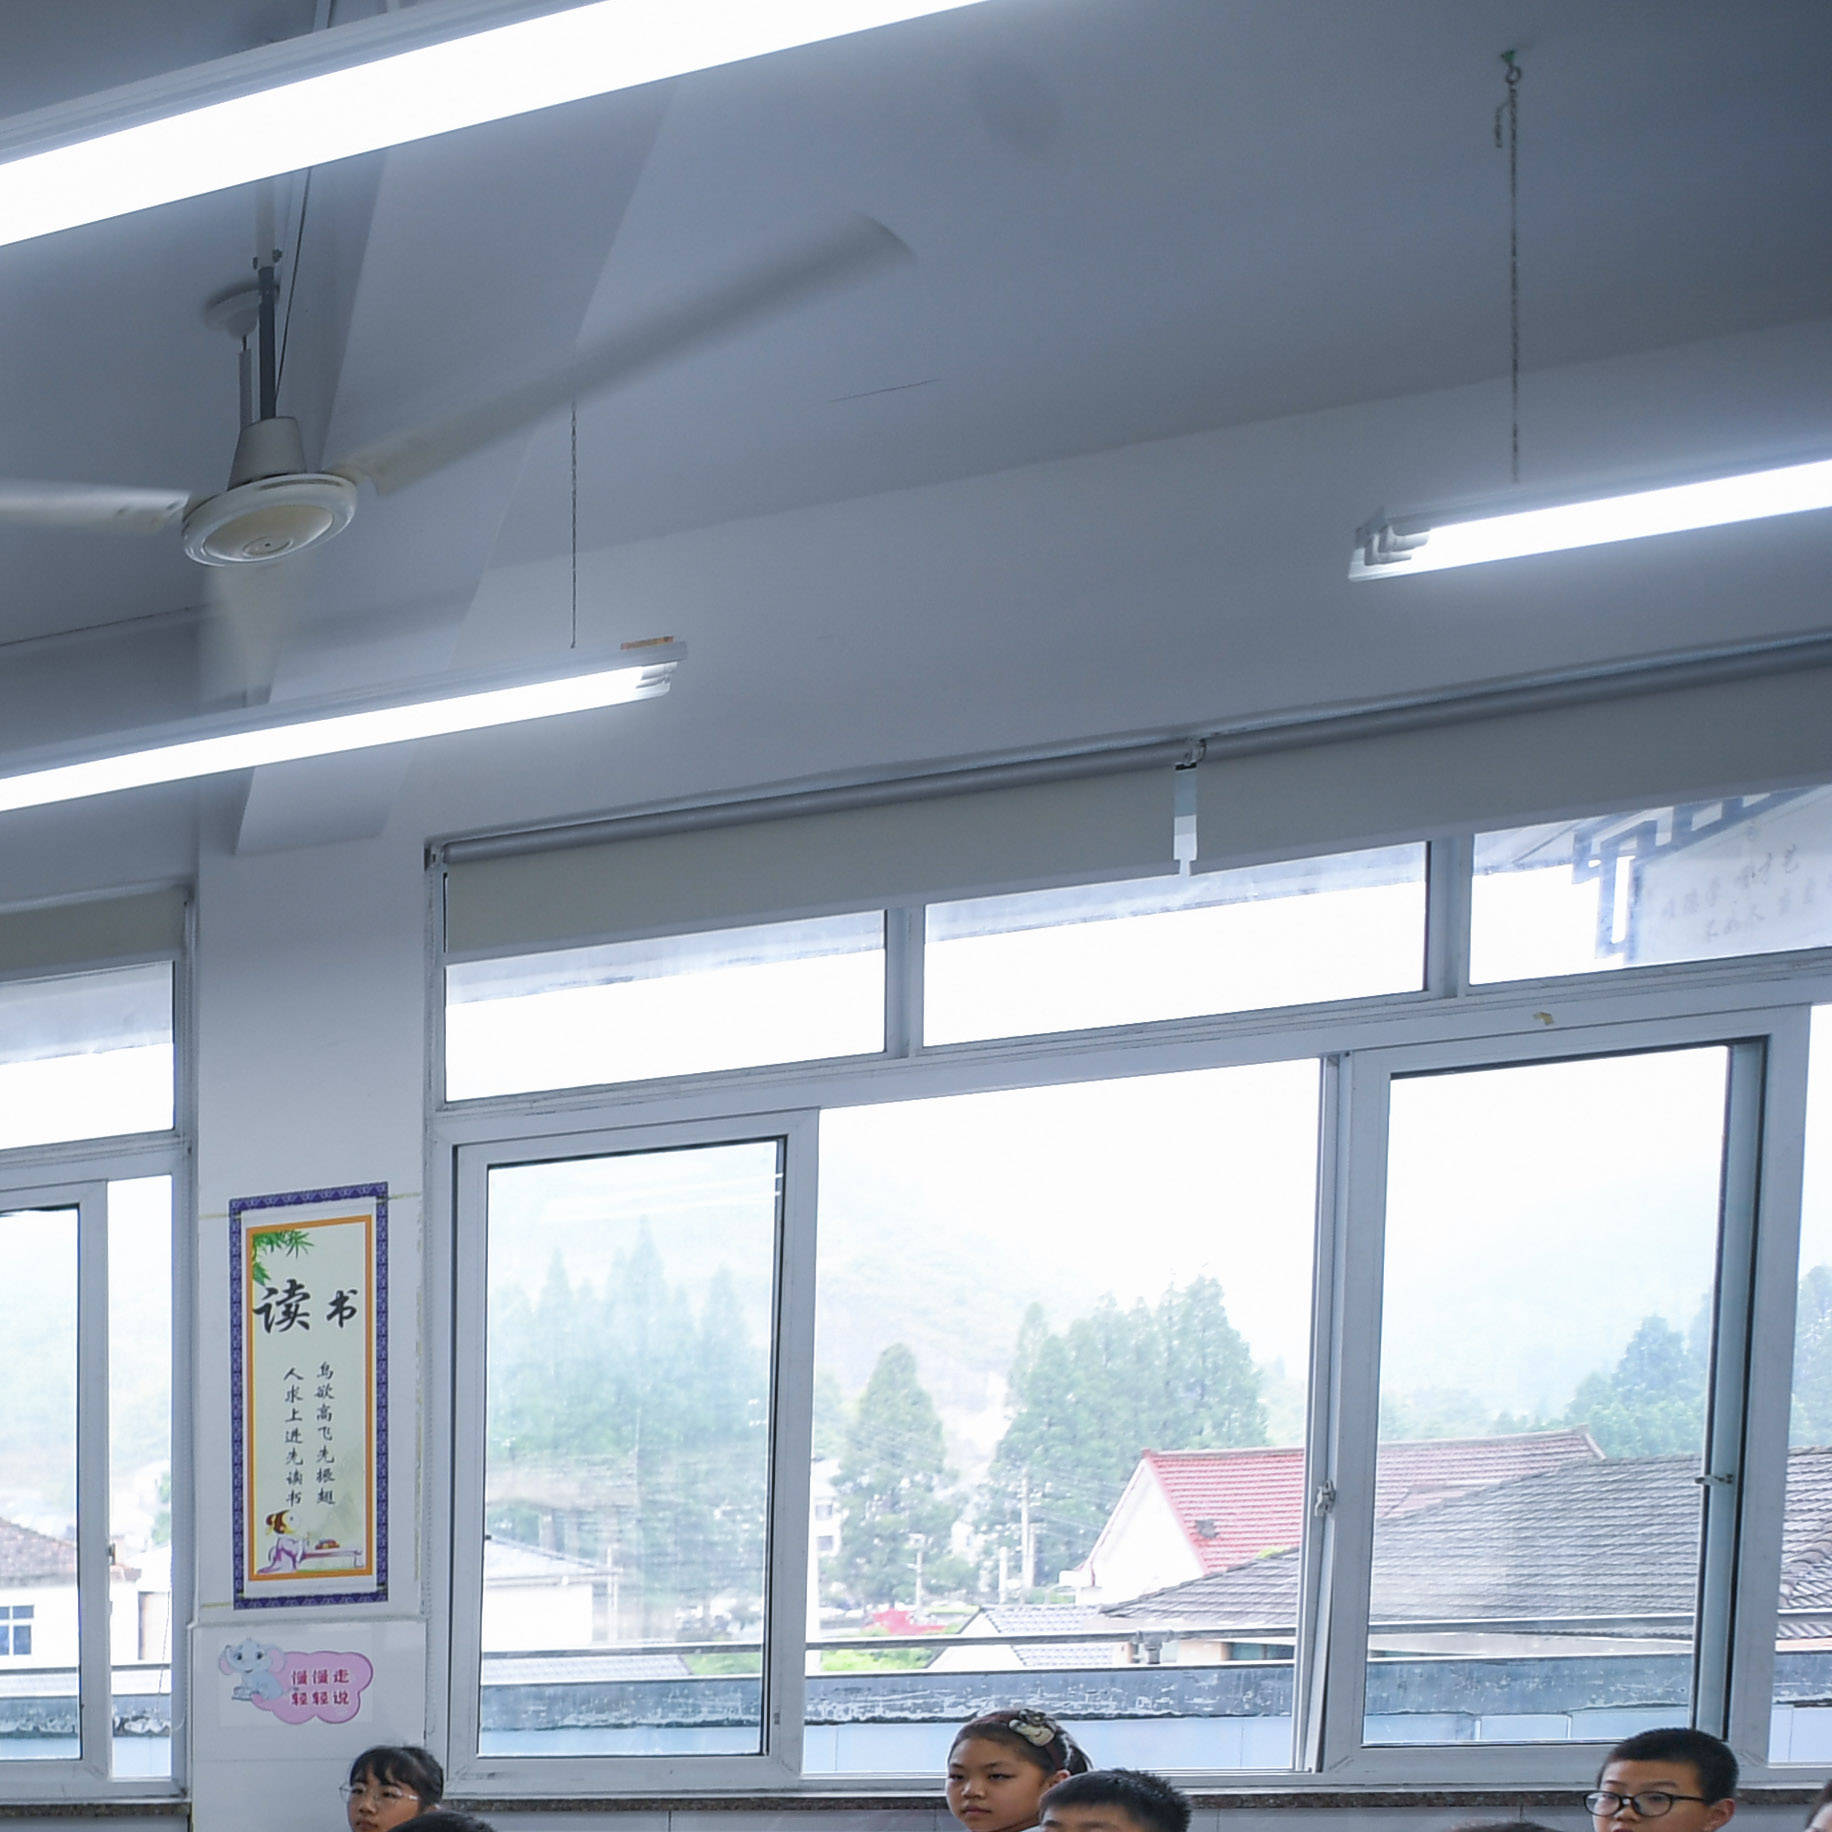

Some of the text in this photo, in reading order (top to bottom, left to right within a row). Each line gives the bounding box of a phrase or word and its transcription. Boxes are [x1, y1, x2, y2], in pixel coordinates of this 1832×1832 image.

[253, 1279, 359, 1334] 读书
[283, 1367, 304, 1507] 人求上进先读书
